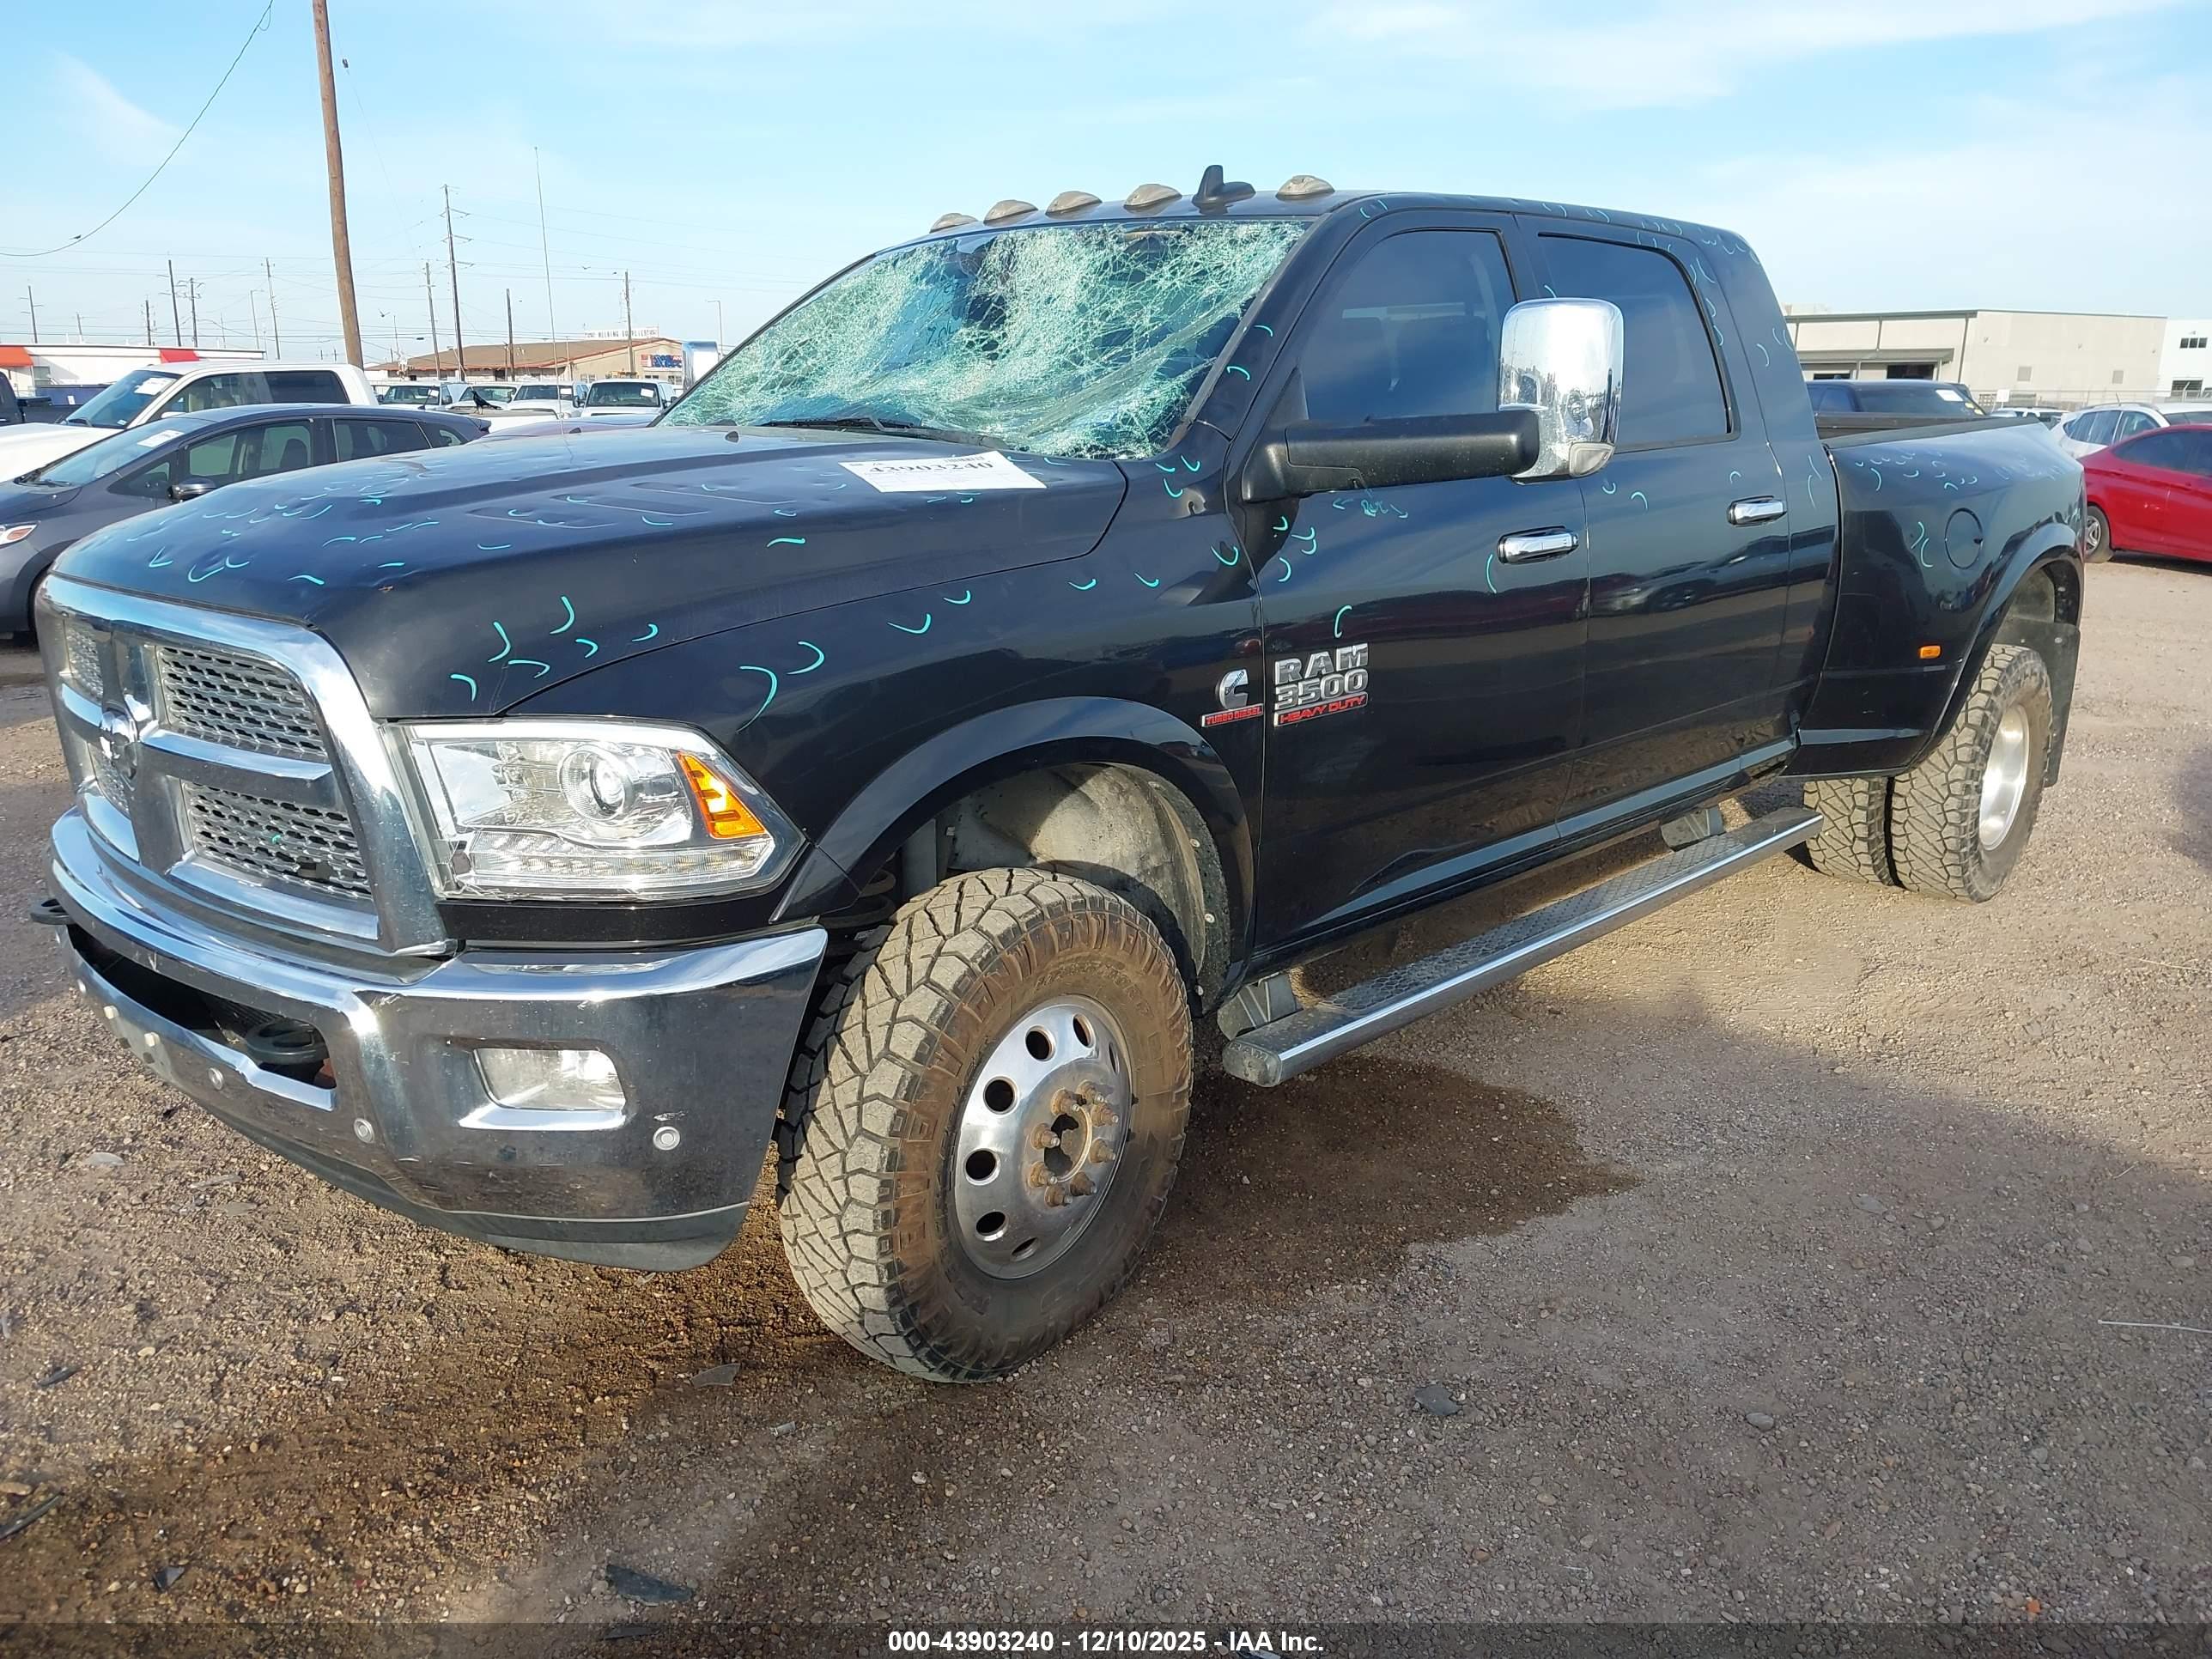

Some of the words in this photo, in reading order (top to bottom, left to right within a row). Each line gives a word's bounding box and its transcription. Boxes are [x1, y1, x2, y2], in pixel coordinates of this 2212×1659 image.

[869, 461, 994, 473] 43903240
[1274, 642, 1368, 685] RAM
[1274, 668, 1368, 711] 3500
[1206, 712, 1234, 725] TURBO
[1234, 706, 1263, 719] DIESEL
[1280, 705, 1328, 723] HEAVY
[1328, 696, 1365, 710] DUTY
